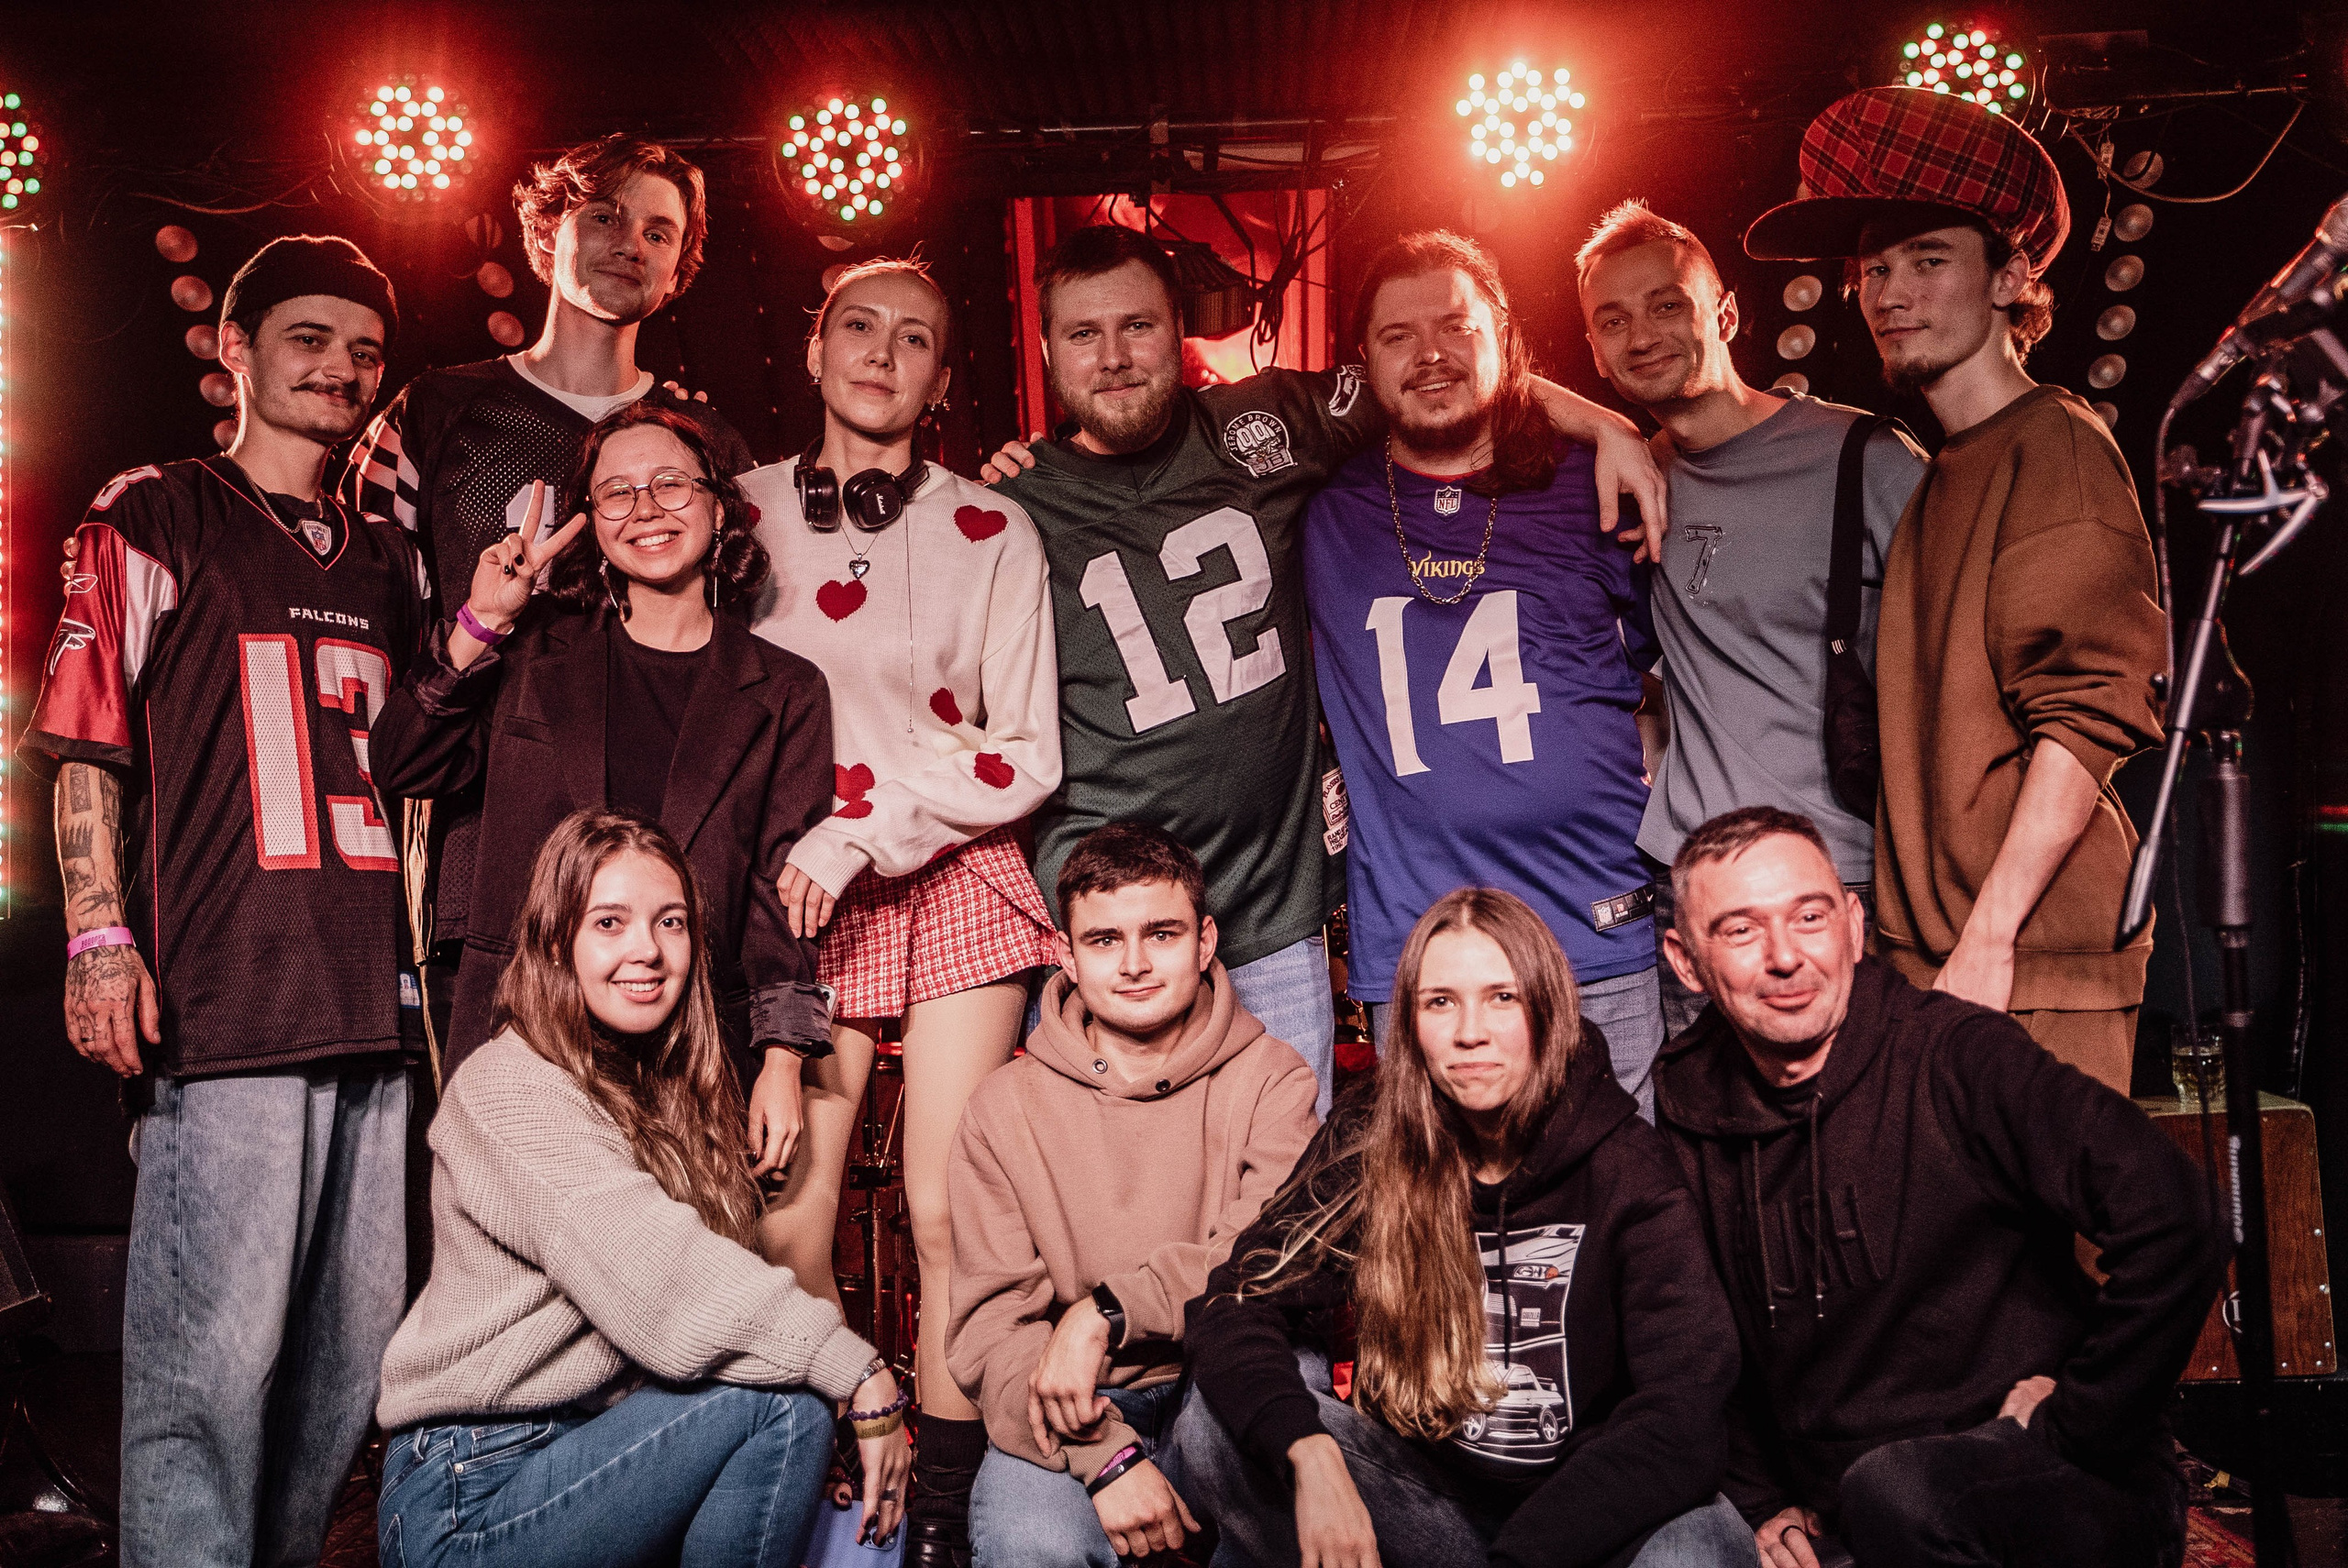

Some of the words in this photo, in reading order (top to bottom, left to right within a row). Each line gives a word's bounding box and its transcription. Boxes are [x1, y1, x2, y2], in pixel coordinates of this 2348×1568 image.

[1227, 418, 1246, 451] JEROME
[1247, 414, 1282, 433] BROWN
[1438, 498, 1456, 510] NFL
[1684, 525, 1723, 594] 7
[289, 607, 370, 630] FALCONS
[1077, 505, 1287, 735] 12
[1365, 590, 1541, 777] 14
[238, 633, 402, 872] 13
